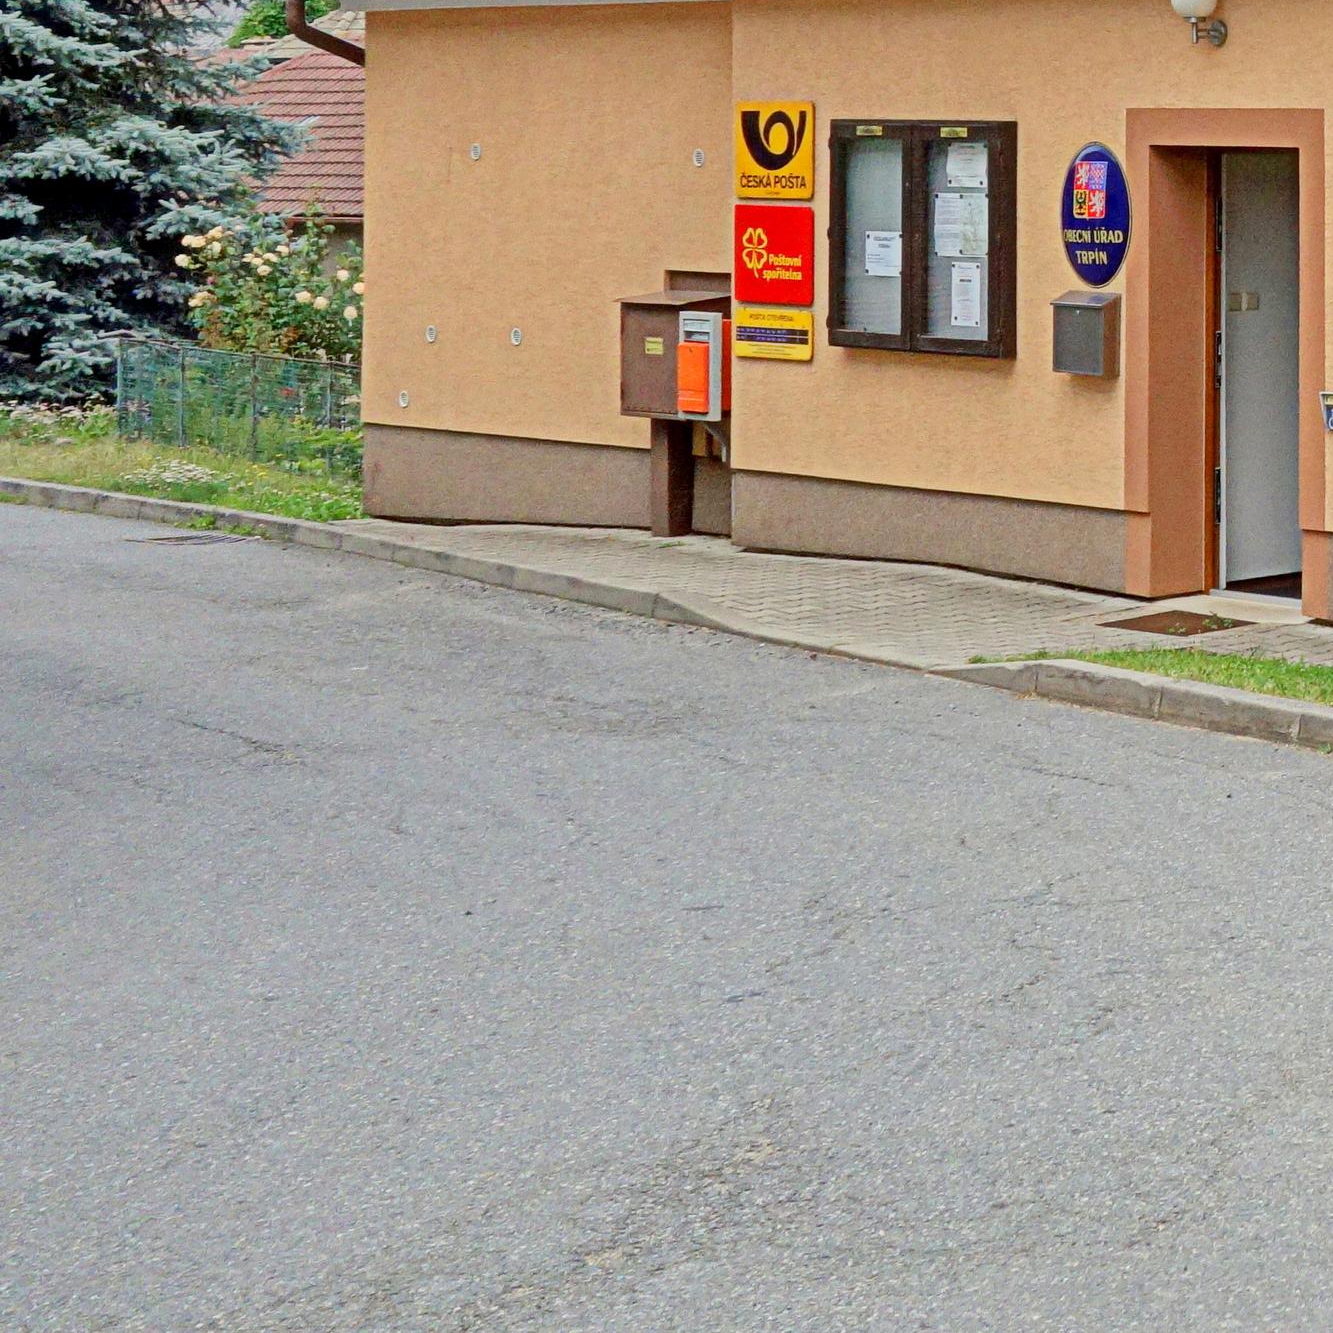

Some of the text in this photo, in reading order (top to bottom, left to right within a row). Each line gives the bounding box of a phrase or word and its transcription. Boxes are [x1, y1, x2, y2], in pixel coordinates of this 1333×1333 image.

[740, 171, 807, 189] ČESKÁ POŠTA
[1064, 226, 1124, 244] OBECNÍ ÚŘAD
[768, 253, 802, 267] Poštovní
[1075, 248, 1108, 265] TRPÍN
[762, 267, 803, 283] spořitelna
